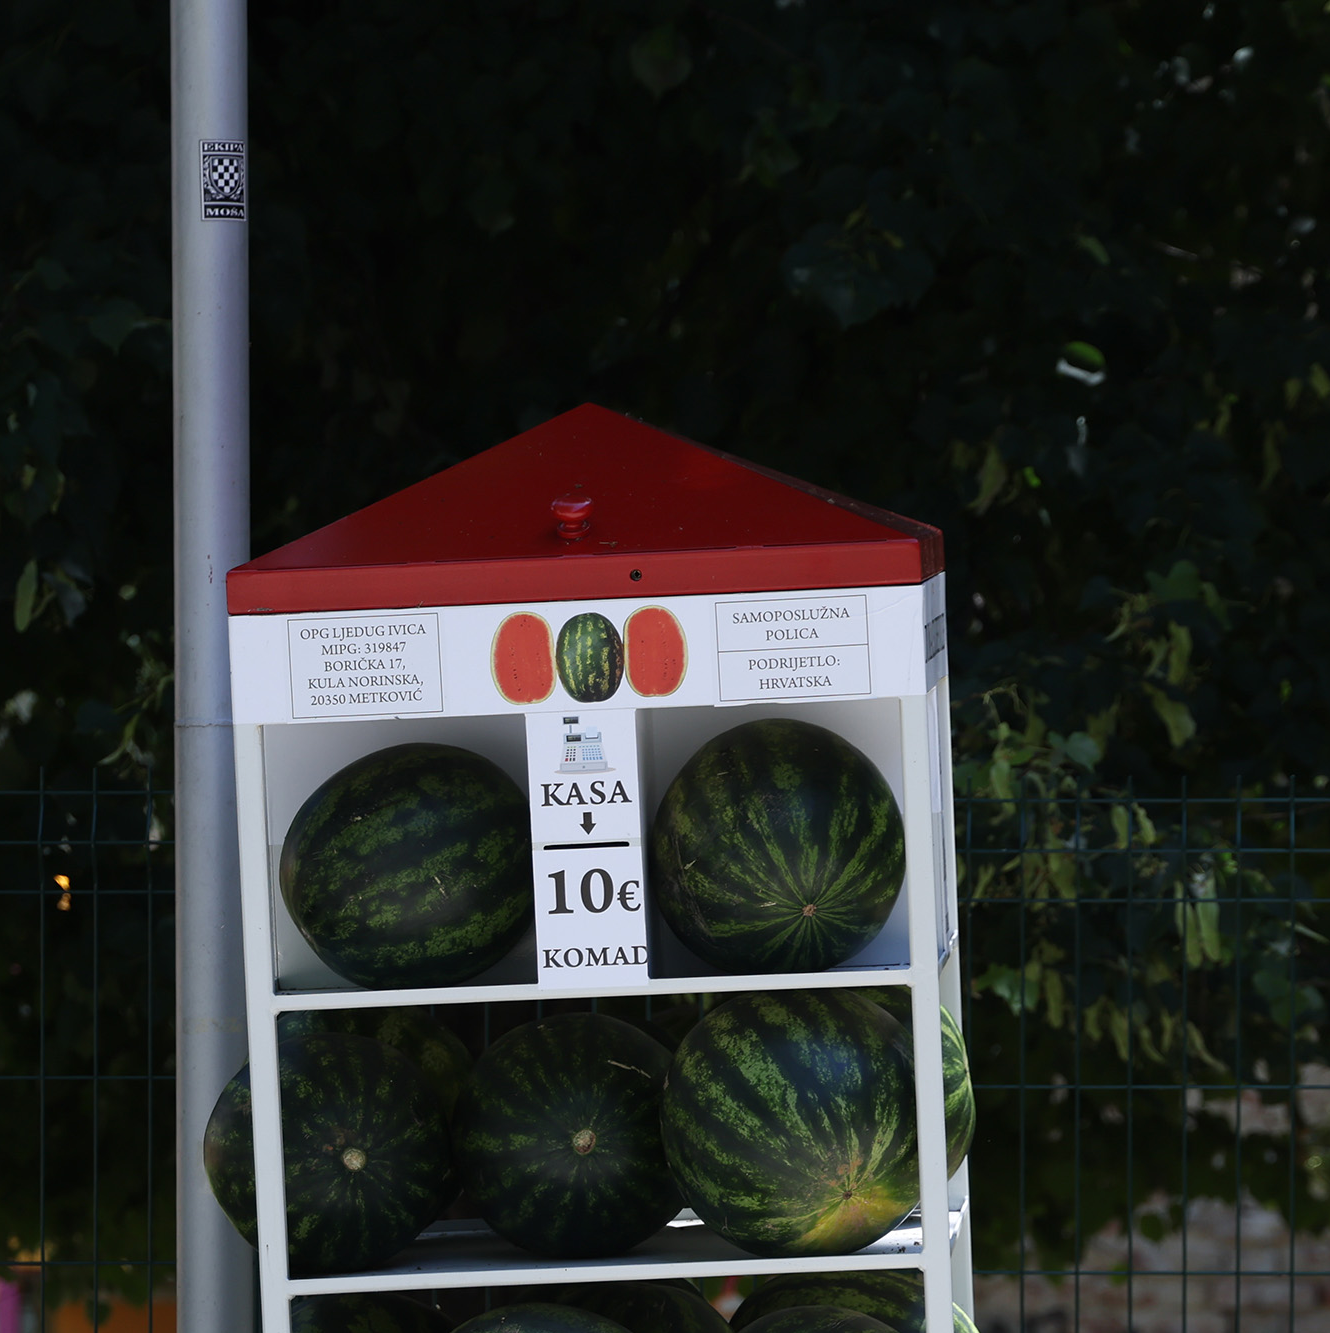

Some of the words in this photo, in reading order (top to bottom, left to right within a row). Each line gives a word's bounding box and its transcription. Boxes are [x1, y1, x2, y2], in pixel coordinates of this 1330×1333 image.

[203, 143, 243, 151] EKIPA
[732, 606, 850, 624] SAMOPOSLUŽNA
[300, 628, 329, 640] OPG
[332, 625, 385, 641] LJEDUG
[388, 624, 426, 636] IVICA
[765, 628, 819, 641] POLICA
[321, 643, 361, 656] MIPG:
[364, 641, 406, 654] 319847
[324, 657, 385, 672] BORIČKA
[390, 658, 406, 671] 17,
[748, 655, 841, 671] PODRIJETLO:
[308, 678, 346, 690] KULA
[348, 674, 424, 688] NORINSKA,
[759, 675, 832, 690] HRVATSKA
[311, 693, 346, 706] 20350
[348, 688, 423, 705] METKOVIĆ
[540, 780, 633, 807] KASA
[547, 868, 642, 915] 10€
[542, 945, 648, 969] KOMAD
